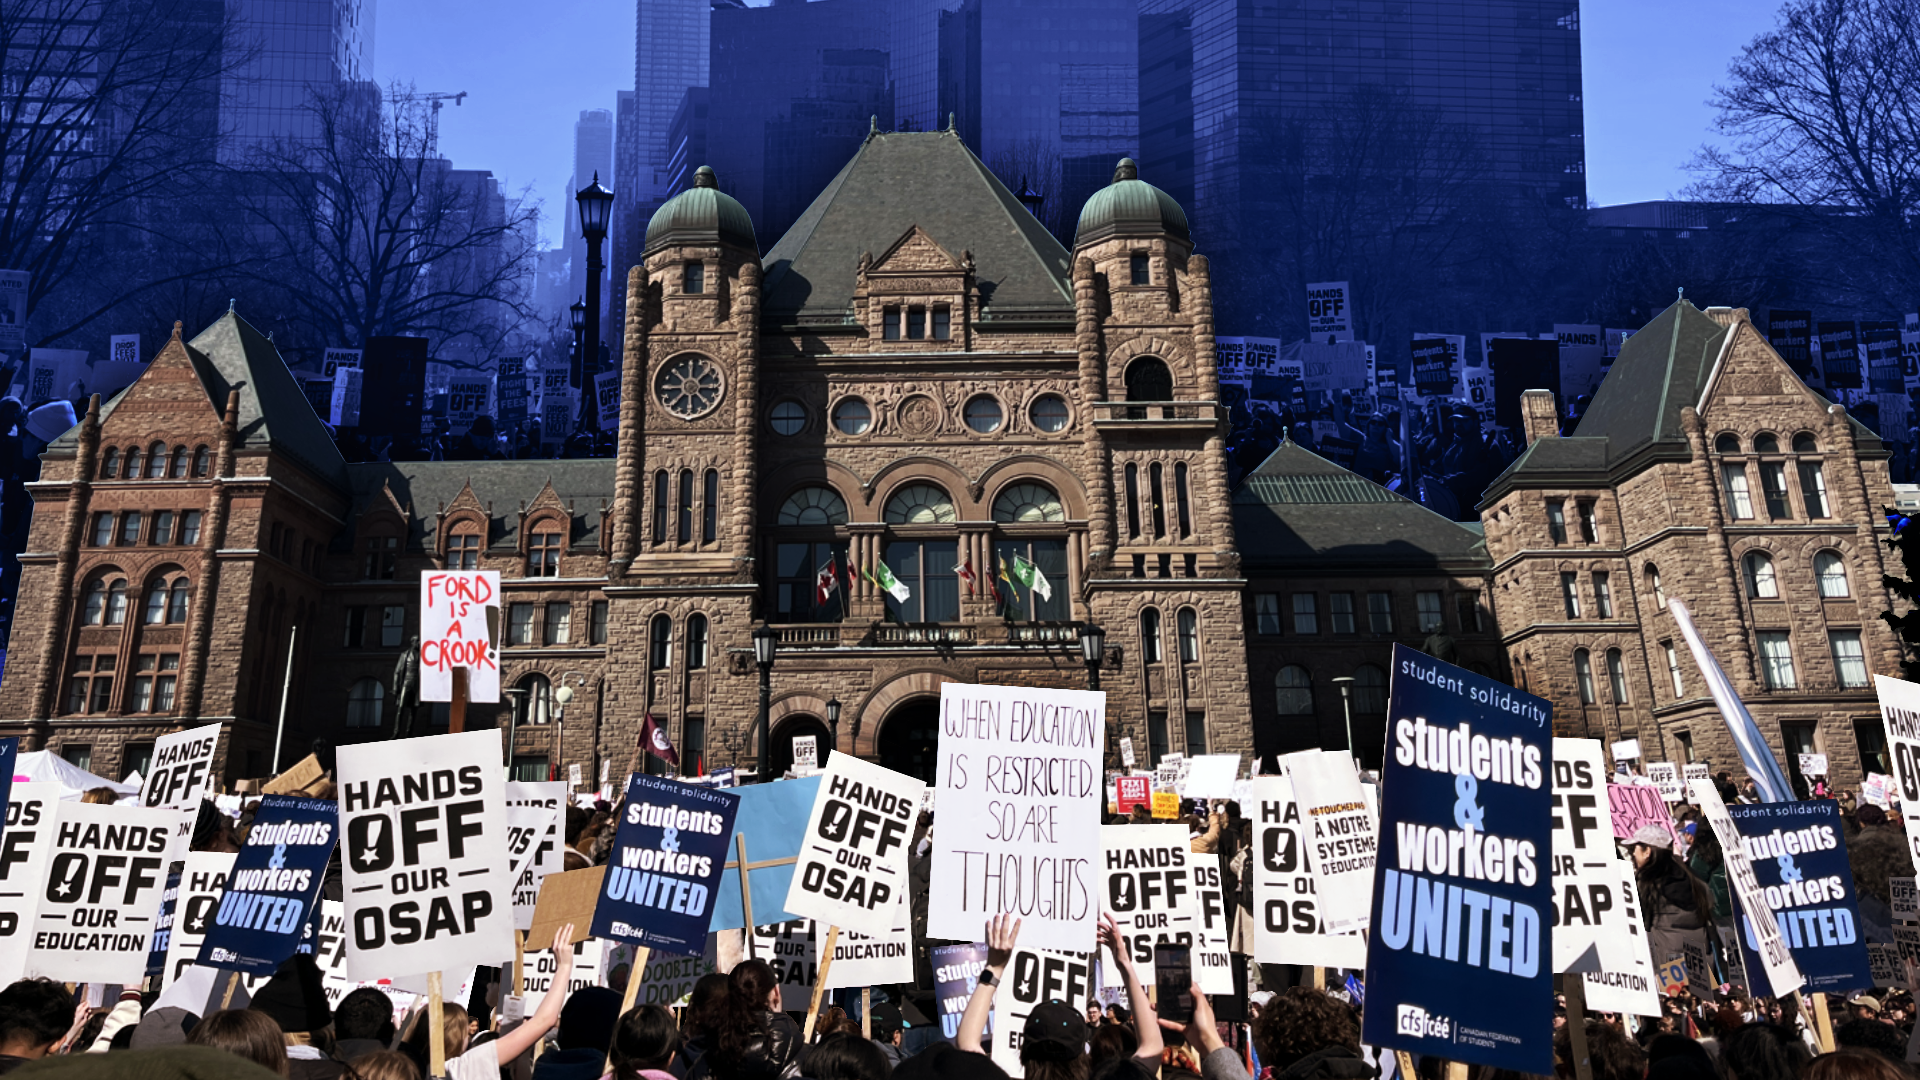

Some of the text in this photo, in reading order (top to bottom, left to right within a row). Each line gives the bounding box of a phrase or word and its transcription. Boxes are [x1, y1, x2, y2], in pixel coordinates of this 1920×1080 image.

[1308, 288, 1343, 299] HANDS
[1309, 299, 1344, 317] OFF
[1311, 324, 1346, 333] EDUCATION
[1319, 317, 1335, 325] OUR
[1770, 319, 1808, 330] students
[115, 341, 136, 350] DROP
[1557, 333, 1597, 345] HANDS
[1772, 336, 1806, 347] workers
[1820, 330, 1853, 344] students
[1868, 339, 1899, 351] students
[115, 349, 136, 358] FEES
[1216, 343, 1243, 352] HANDS
[1246, 342, 1277, 354] HANDS
[1413, 346, 1444, 358] students
[1780, 346, 1807, 361] NITED
[1824, 348, 1855, 361] workers
[326, 351, 359, 362] HANDS
[500, 356, 523, 364] HANDS
[1216, 352, 1243, 367] OFF
[1245, 352, 1277, 369] OFF
[1870, 356, 1899, 368] workers
[500, 364, 523, 375] OFF
[545, 368, 569, 376] HANDS
[1279, 366, 1301, 375] ANDS
[1416, 361, 1446, 372] workers
[1823, 359, 1858, 374] UNITED
[1869, 366, 1901, 380] UNITED
[500, 378, 526, 389] FIGHT
[545, 375, 568, 388] OFF
[1415, 370, 1448, 384] UNITED
[451, 384, 487, 394] HANDS
[504, 388, 522, 397] THE
[600, 387, 619, 406] OFF
[450, 394, 486, 412] OFF
[500, 397, 526, 410] FEES
[545, 405, 570, 414] DROP
[545, 413, 569, 423] FEES
[545, 422, 568, 433] NOT
[427, 574, 492, 608] FORD
[450, 601, 470, 618] IS
[446, 619, 462, 639] A
[1401, 659, 1547, 728] student solidarity
[944, 698, 1096, 749] WHEN EDUCATION
[1886, 706, 1920, 740] HAND
[155, 737, 214, 767] HANDS
[795, 746, 815, 757] OFF
[1395, 716, 1542, 790] students
[948, 753, 968, 790] IS
[1650, 772, 1673, 783] OFF
[145, 761, 208, 807] OFF
[345, 765, 483, 812] HANDS
[1659, 787, 1677, 795] SAP
[635, 777, 732, 809] student solidarity
[828, 774, 913, 821] HANDS
[262, 798, 295, 810] student
[1453, 773, 1485, 832] &
[626, 802, 724, 836] students
[1729, 804, 1832, 819] tudent solidarity
[817, 799, 908, 858] OFF
[986, 801, 1058, 844] SO ARE
[1314, 814, 1372, 839] À NOTRE
[57, 821, 168, 853] HANDS
[248, 819, 332, 846] students
[348, 800, 484, 874] OFF
[660, 826, 680, 852] &
[1317, 834, 1376, 860] SYSTÈME
[1396, 821, 1537, 887] workers
[268, 843, 287, 869] &
[622, 846, 712, 878] workers
[835, 848, 873, 873] OUR
[1106, 847, 1185, 870] HANDS
[1777, 854, 1804, 883] &
[46, 852, 162, 905] OFF
[234, 867, 312, 892] workers
[391, 867, 450, 895] OUR
[801, 861, 892, 911] OSAP
[951, 850, 1089, 922] THOUGHTS
[1891, 880, 1916, 888] HANDS
[606, 866, 709, 918] UNITED
[1109, 870, 1187, 912] OFF
[1760, 875, 1845, 910] orkers
[1892, 887, 1917, 899] OFF
[71, 908, 117, 928] OUR
[215, 890, 304, 935] UNITED
[354, 890, 493, 950] OSAP
[1134, 914, 1168, 929] OUR
[1380, 867, 1540, 979] UNITED
[34, 932, 146, 951] EDUCATION
[774, 941, 805, 957] OUR
[831, 942, 906, 961] DUCATION
[537, 958, 558, 974] OU
[1587, 970, 1648, 993] EDUCATION
[1400, 1008, 1422, 1034] cfs
[1459, 1026, 1489, 1039] CANADIAN
[1488, 1031, 1522, 1045] FEDERATION
[1468, 1037, 1496, 1049] STUDENTS
